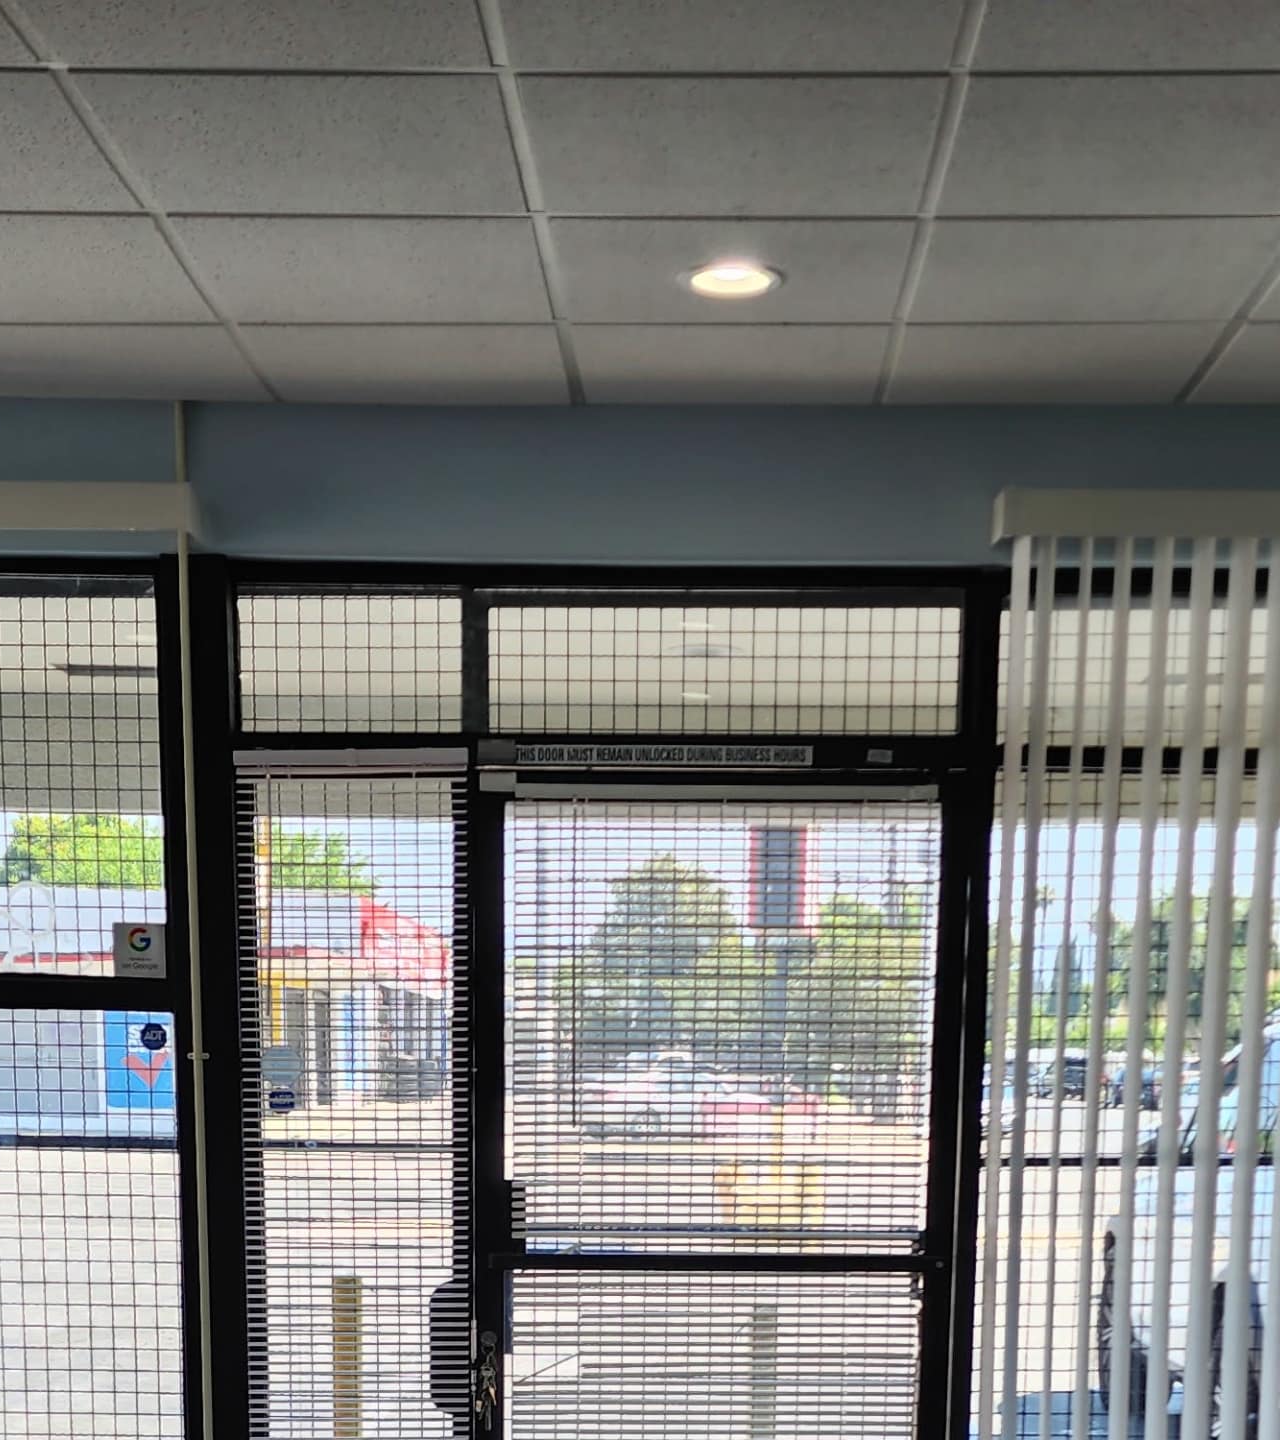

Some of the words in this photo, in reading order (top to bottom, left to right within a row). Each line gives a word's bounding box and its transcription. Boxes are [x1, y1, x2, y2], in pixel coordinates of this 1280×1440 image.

[515, 747, 536, 762] THIS
[537, 747, 564, 762] DOOR
[566, 747, 593, 762] MUST
[596, 747, 633, 762] REMAIN
[634, 747, 685, 762] UNLOCKED
[686, 747, 723, 762] DURING
[725, 747, 771, 762] BUSINESS
[773, 747, 806, 762] HOURS
[143, 1030, 164, 1041] ADT
